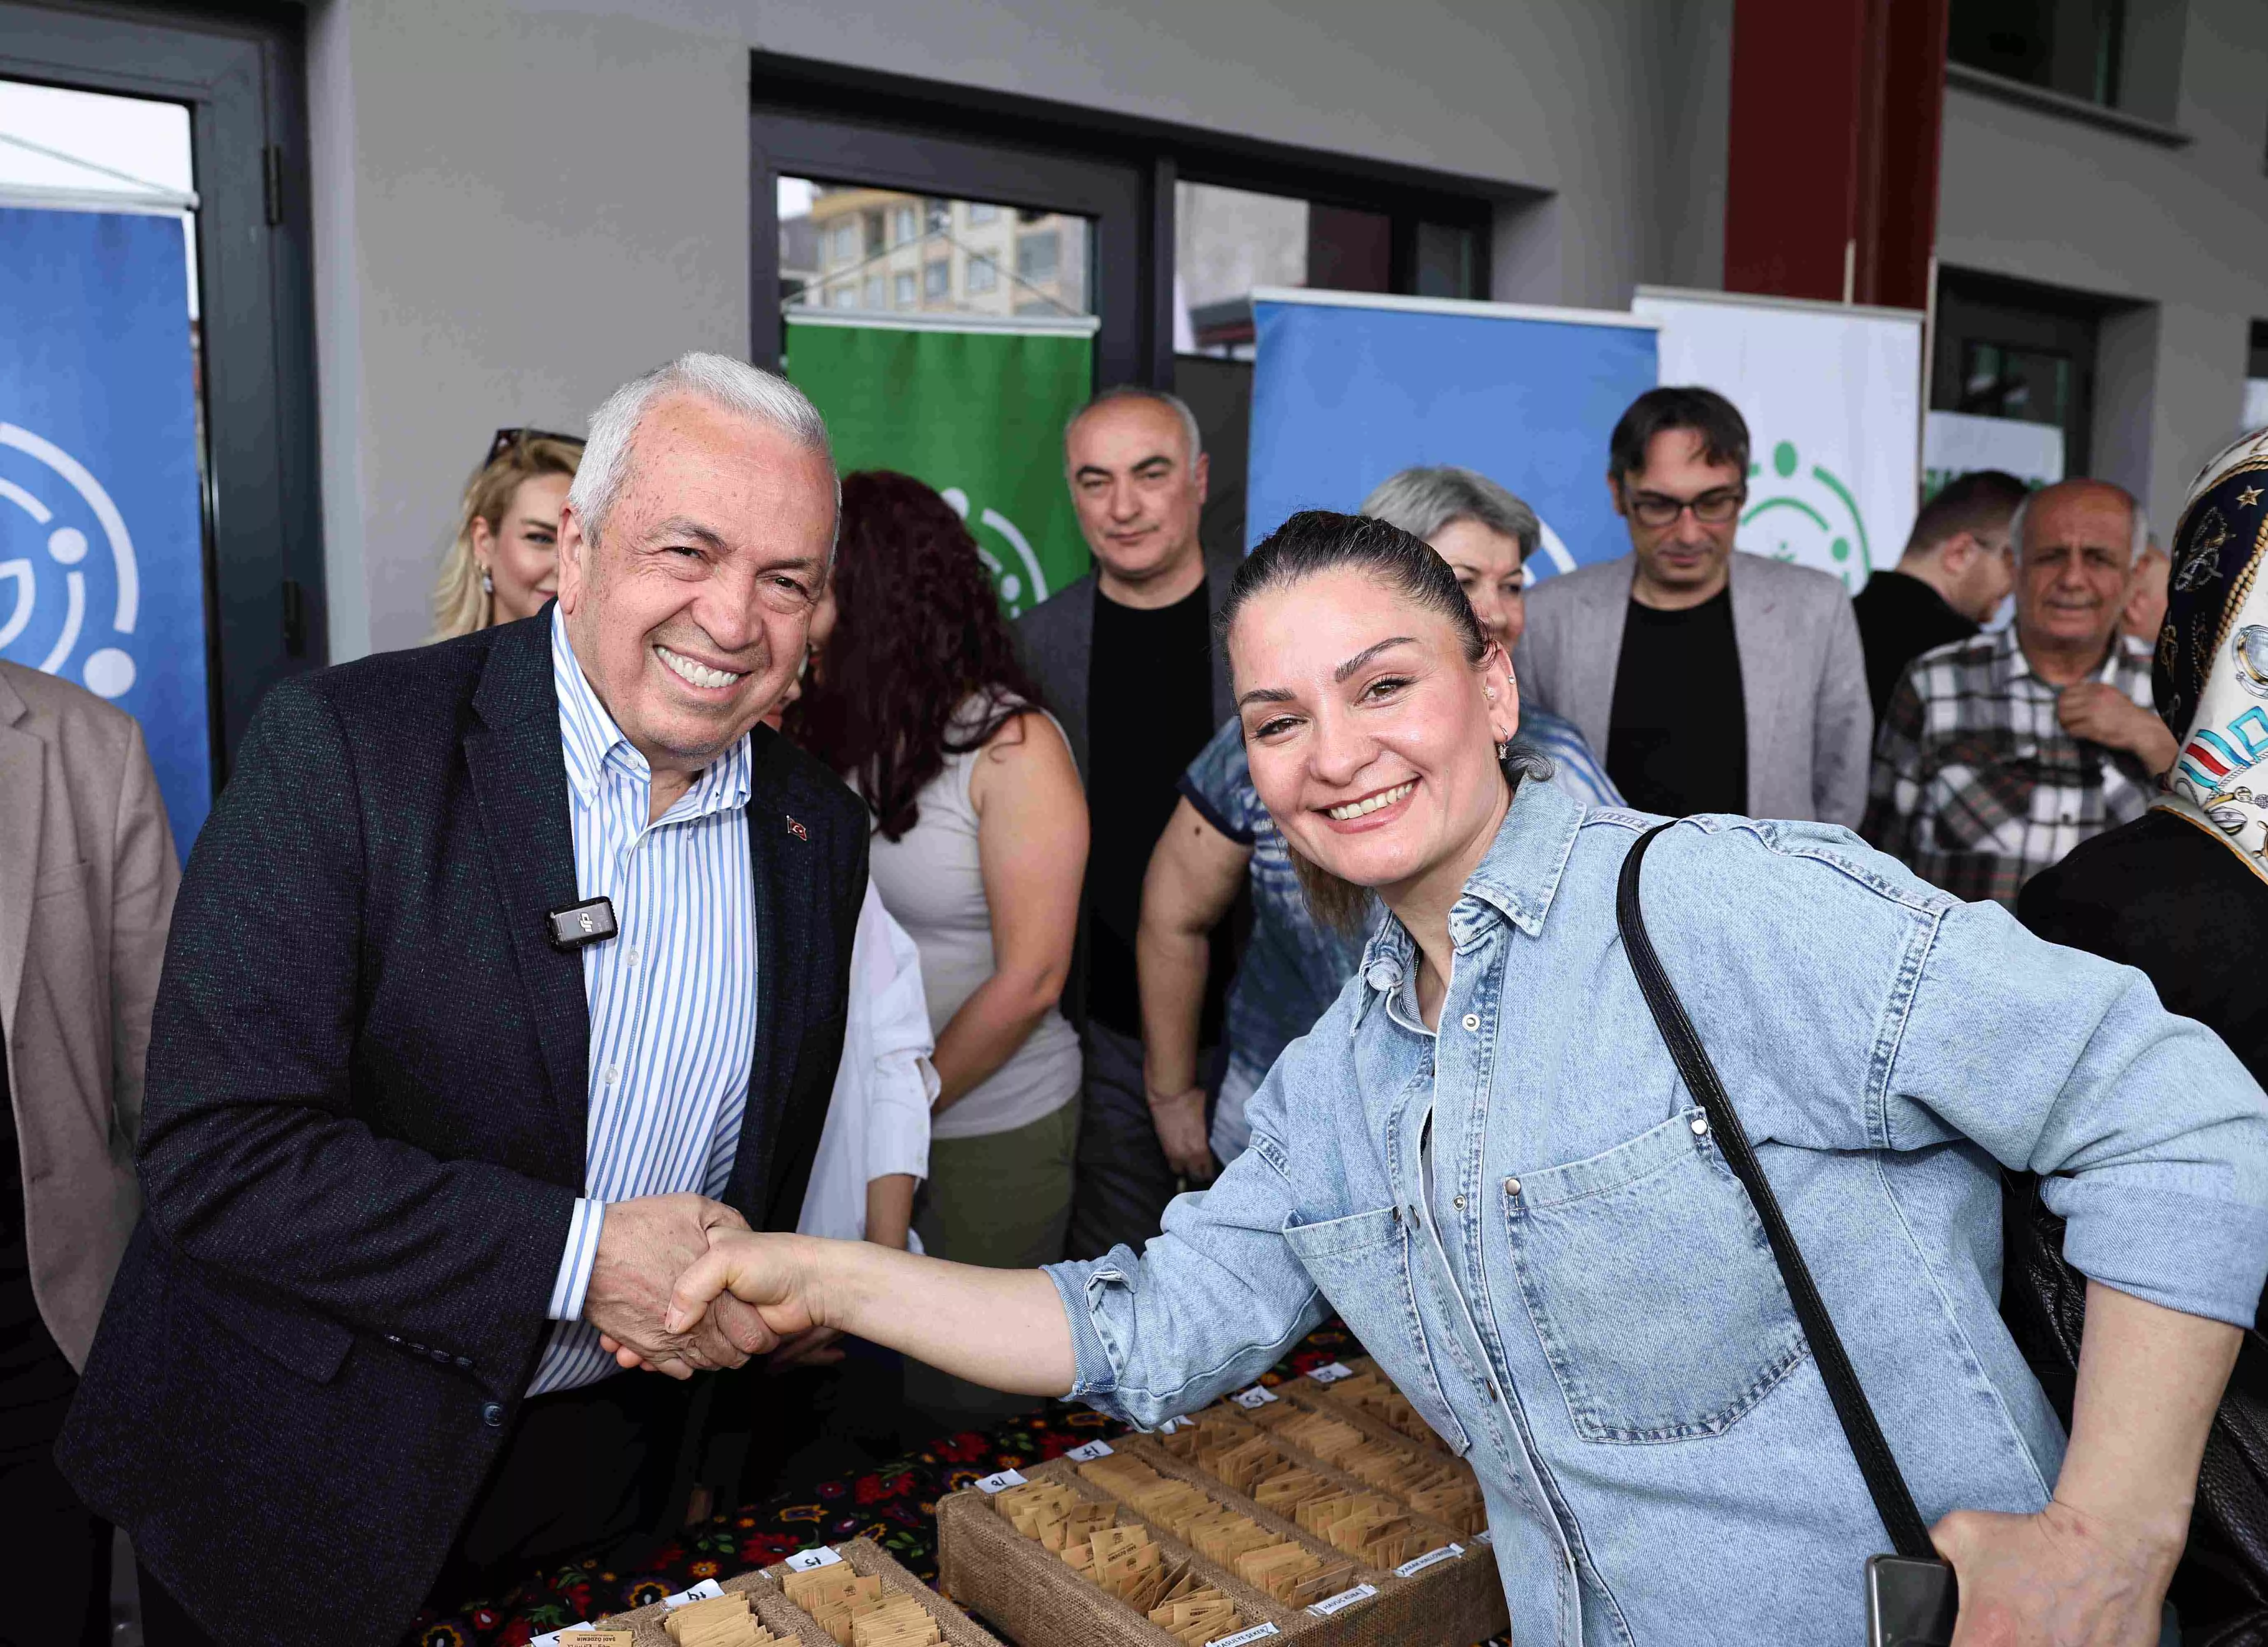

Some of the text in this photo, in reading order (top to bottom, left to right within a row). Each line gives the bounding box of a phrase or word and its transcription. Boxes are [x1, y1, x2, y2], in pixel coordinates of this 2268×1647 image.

[1082, 1446, 1100, 1457] 17
[804, 1556, 822, 1568] 15
[1323, 1598, 1345, 1610] HAVUÇ
[1245, 1629, 1266, 1639] ŞEKER
